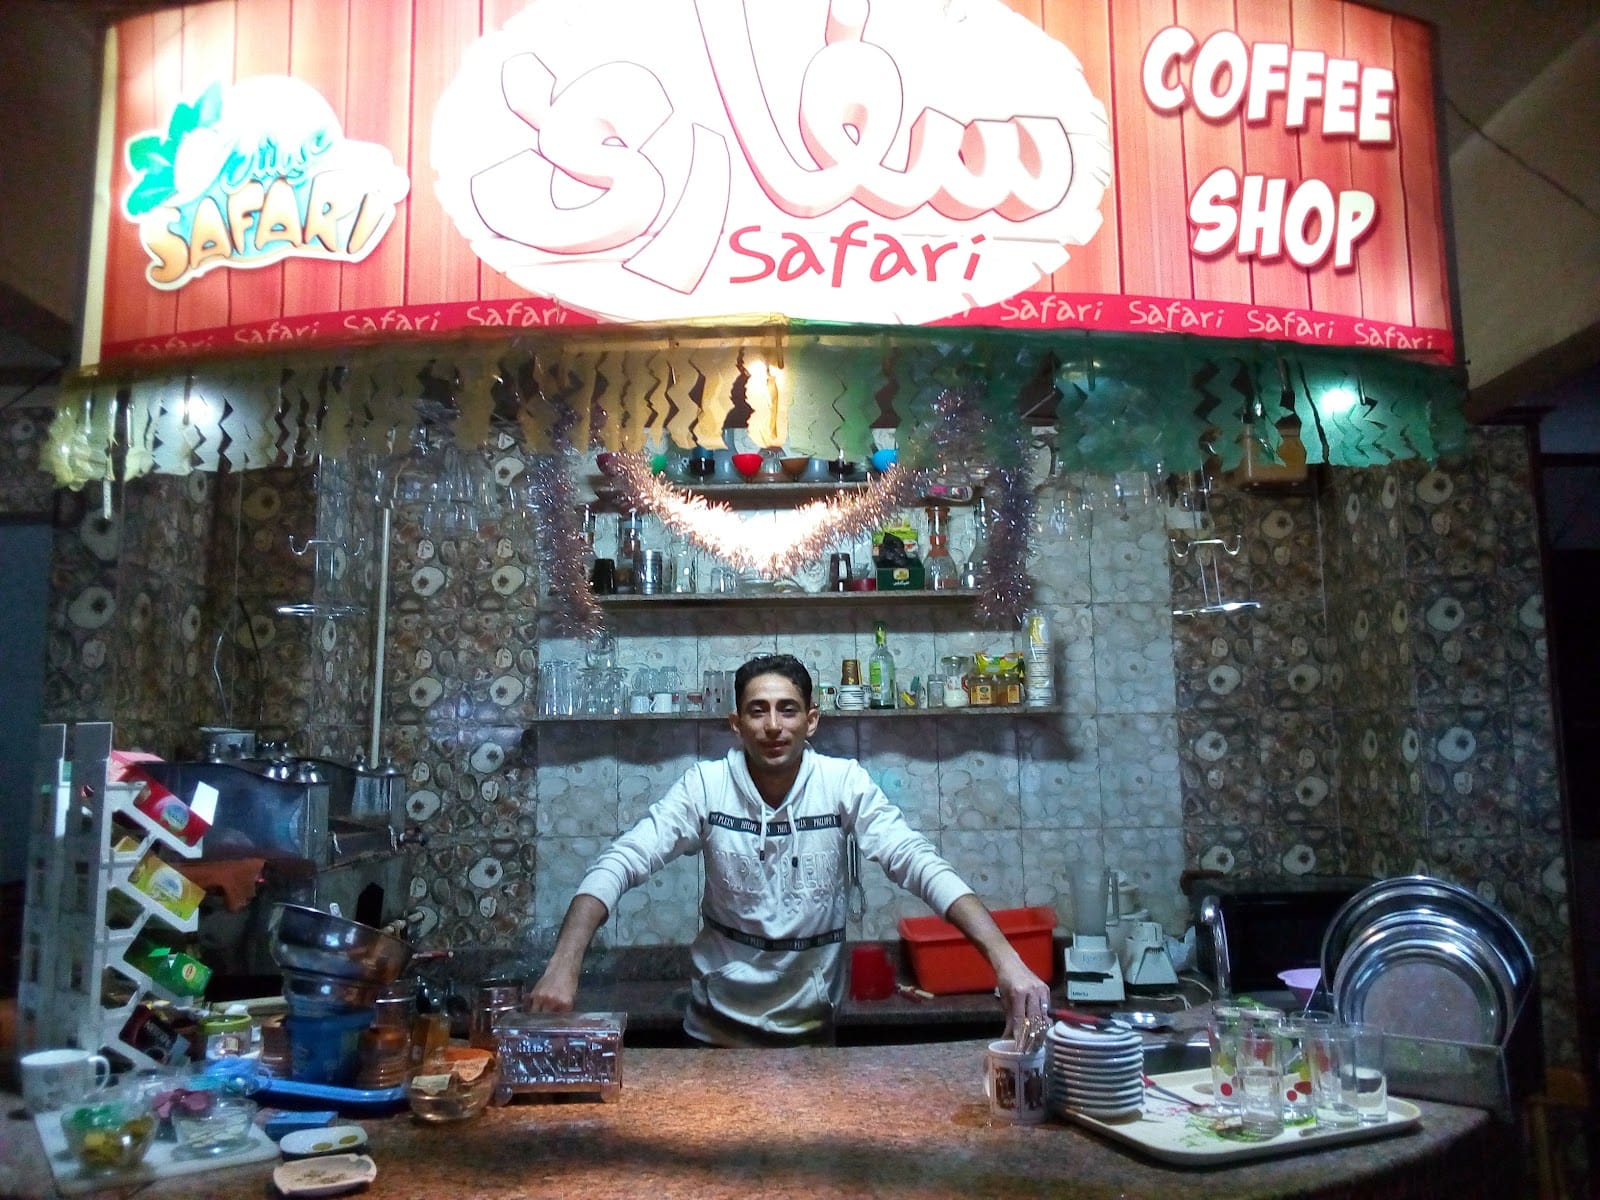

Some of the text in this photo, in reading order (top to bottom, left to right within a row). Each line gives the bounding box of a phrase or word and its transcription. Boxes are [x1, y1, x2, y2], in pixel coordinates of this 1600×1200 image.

[1143, 26, 1396, 143] COFFEE
[146, 170, 390, 284] SAFARI
[729, 220, 987, 288] Safari
[1188, 168, 1376, 270] SHOP
[234, 321, 320, 344] Safari
[343, 309, 441, 332] Safari
[466, 302, 568, 327] Safari
[1000, 296, 1104, 324] Safari
[1129, 301, 1225, 330] Safari
[1247, 310, 1335, 340] Safari
[1354, 323, 1433, 350] Safari
